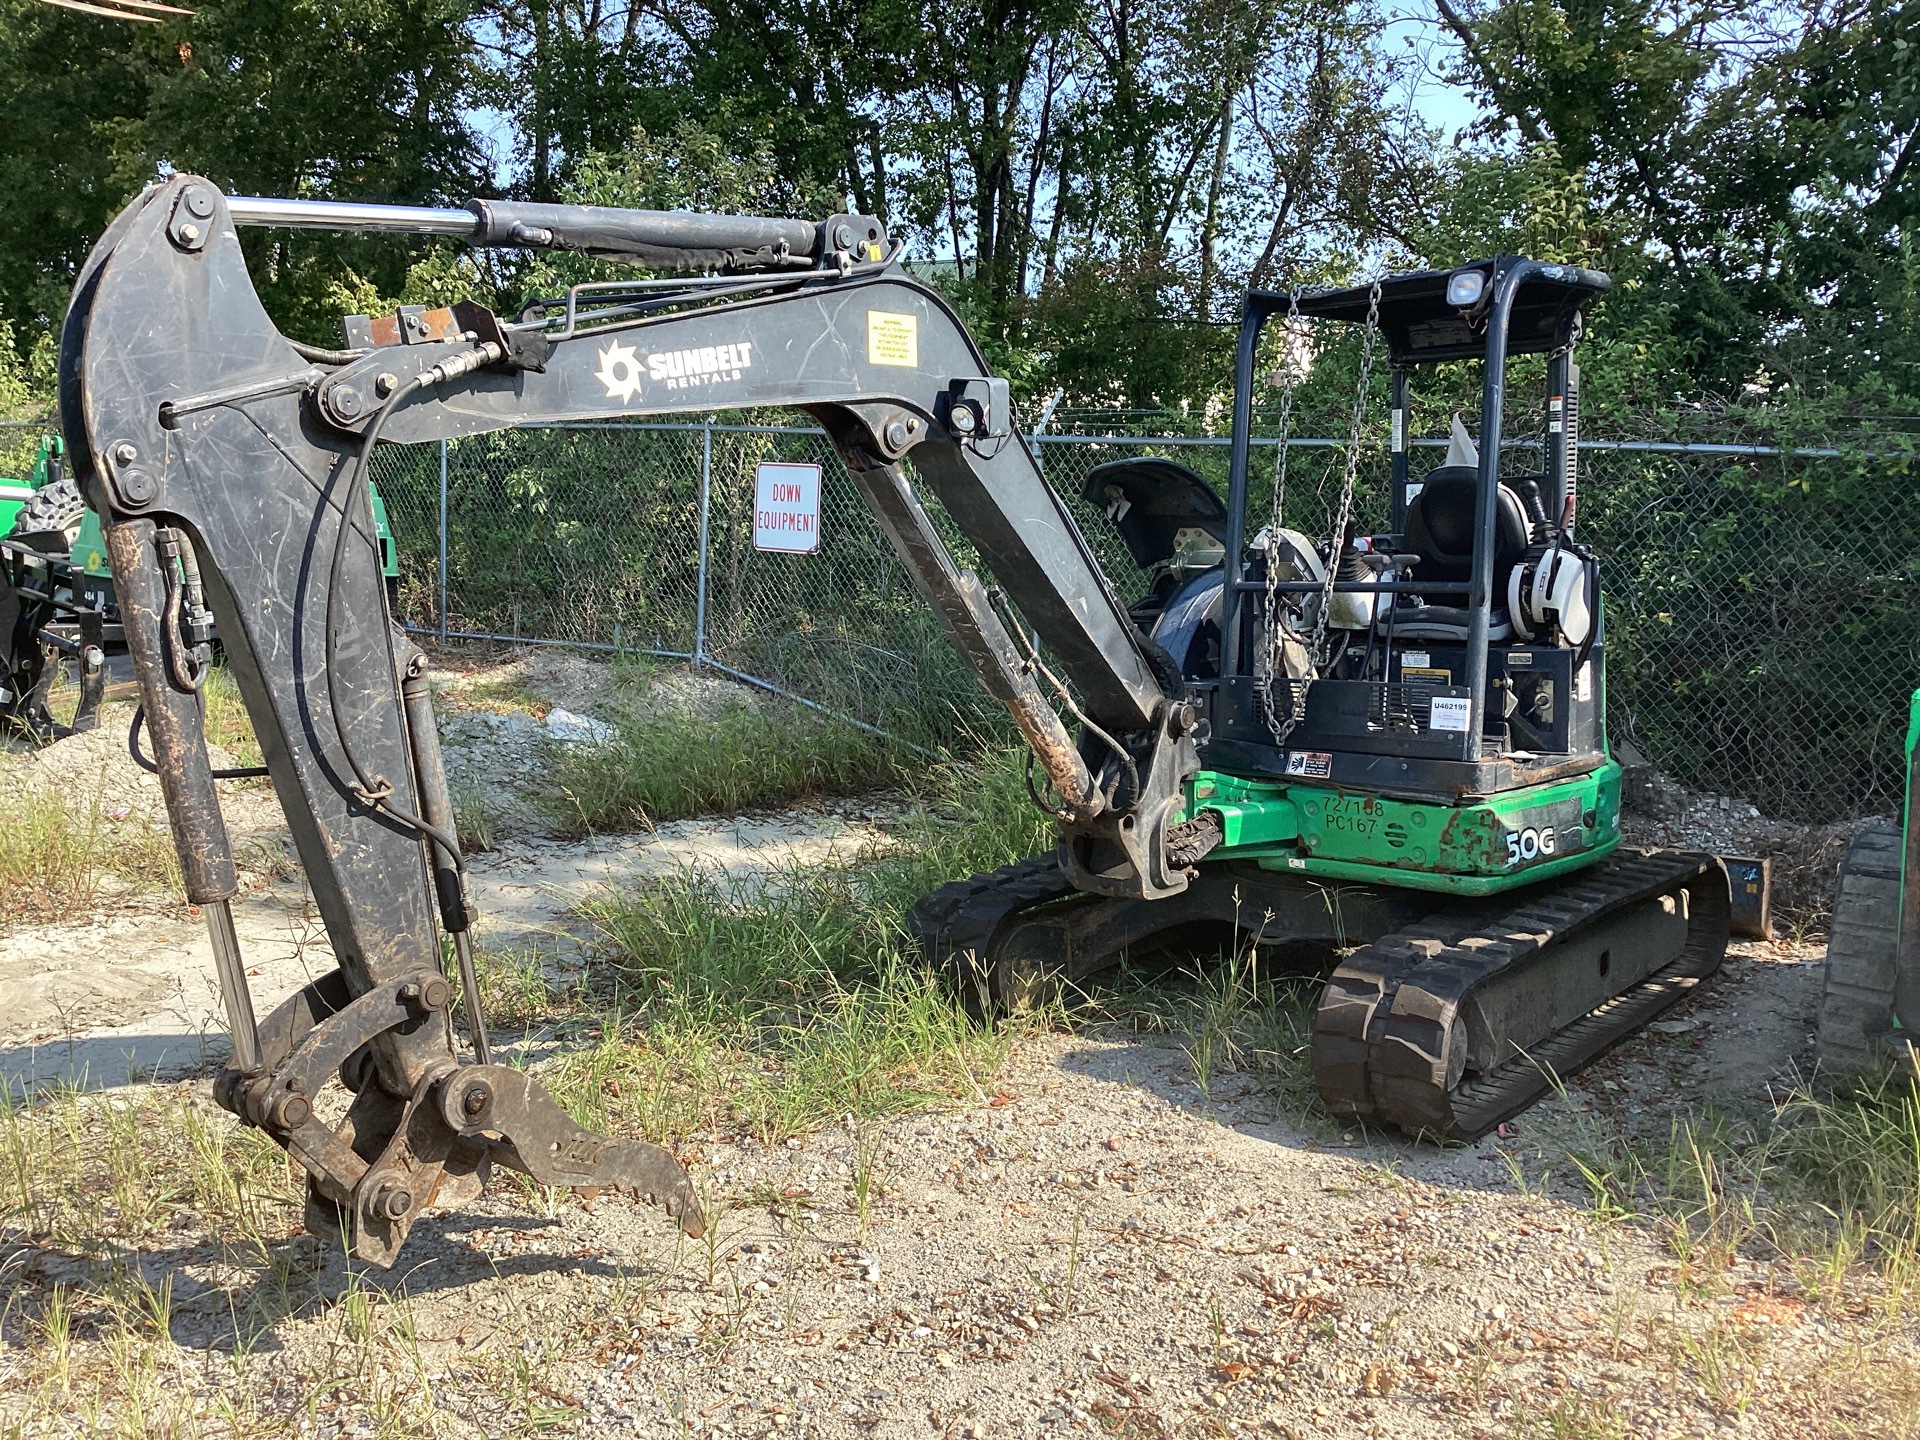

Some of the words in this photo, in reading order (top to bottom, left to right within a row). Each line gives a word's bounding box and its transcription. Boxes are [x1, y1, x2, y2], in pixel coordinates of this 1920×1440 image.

[648, 342, 752, 380] SUNBELT
[667, 369, 742, 390] RENTALS
[773, 483, 801, 502] DOWN
[758, 510, 815, 532] EQUIPMENT
[1434, 702, 1468, 711] U462199
[1326, 814, 1377, 833] PC167
[1505, 826, 1556, 867] 50G
